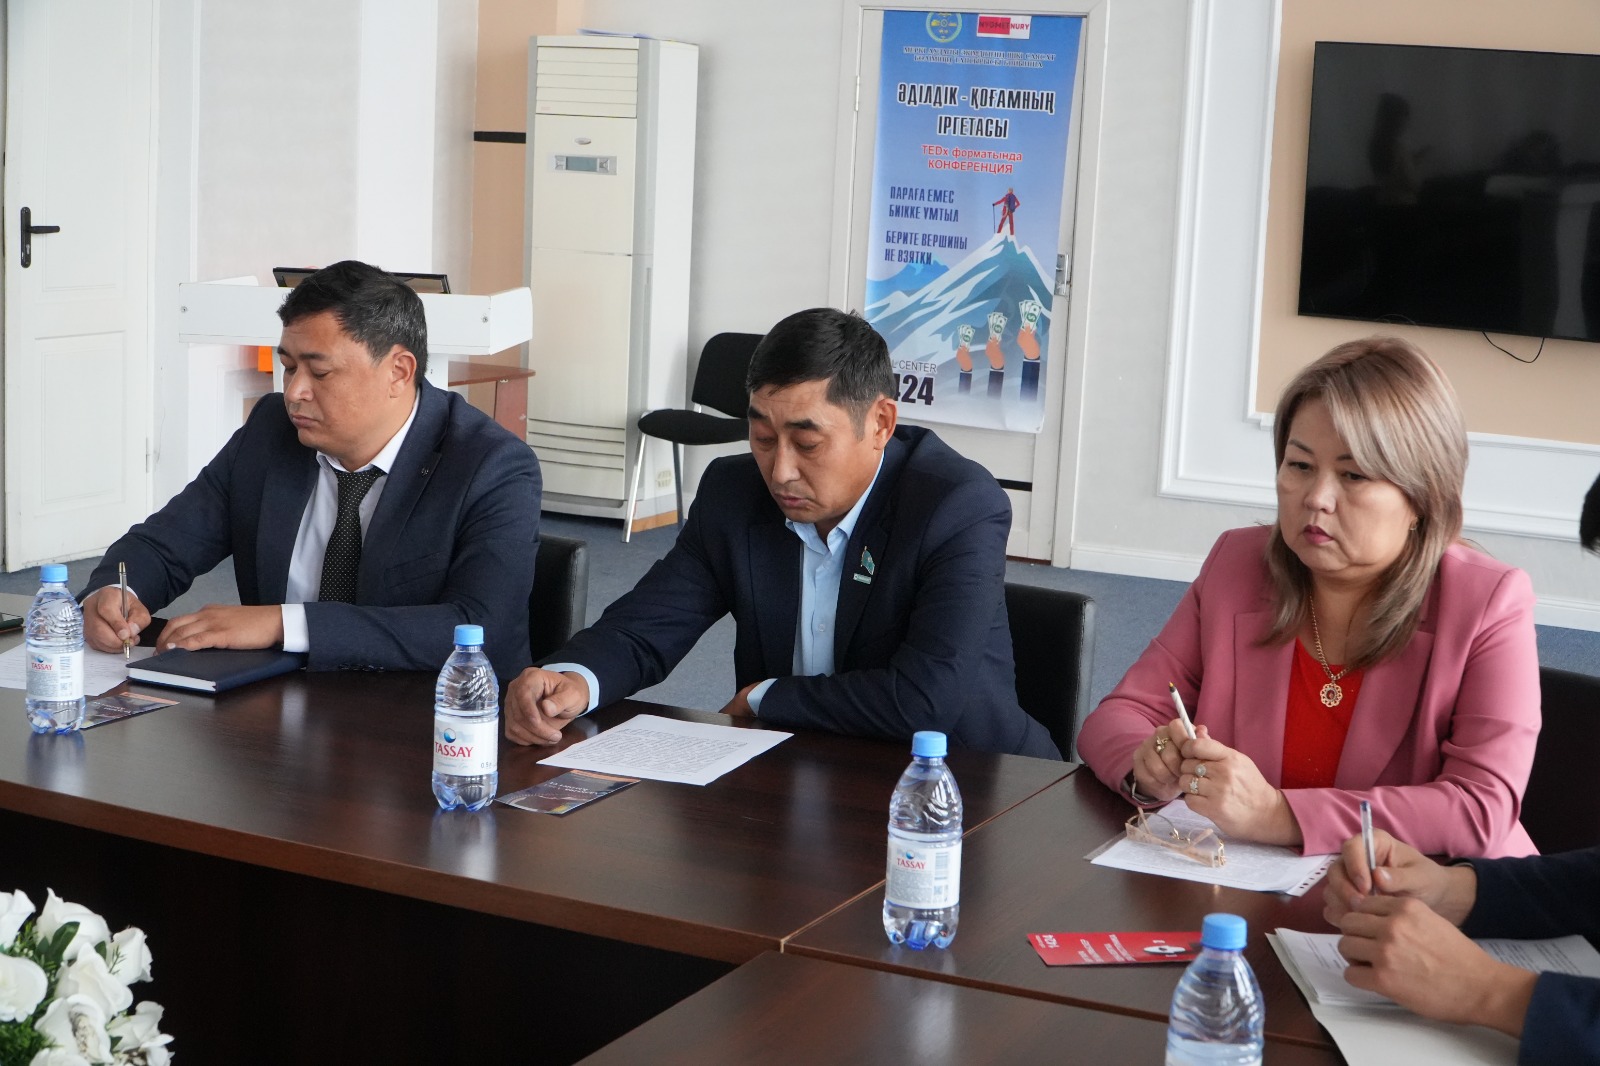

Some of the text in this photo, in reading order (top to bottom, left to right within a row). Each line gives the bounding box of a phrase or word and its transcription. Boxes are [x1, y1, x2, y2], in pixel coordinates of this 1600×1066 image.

[898, 83, 958, 106] ӘДІЛДІК
[970, 88, 1054, 114] ҚОҒАМНЫҢ
[938, 115, 1008, 138] ІРГЕТАСЫ
[922, 145, 1022, 161] TEDx форматында
[928, 159, 1013, 174] КОНФЕРЕНЦИЯ
[927, 189, 955, 204] ЕМЕС
[886, 230, 968, 250] БЕРИТЕ ВЕРШИНЫ
[884, 248, 932, 265] НЕ ВЗЯТКИ
[898, 360, 937, 372] CENTER
[31, 663, 53, 671] TASSAY
[434, 742, 474, 758] TASSAY
[897, 857, 926, 870] TASSAY
